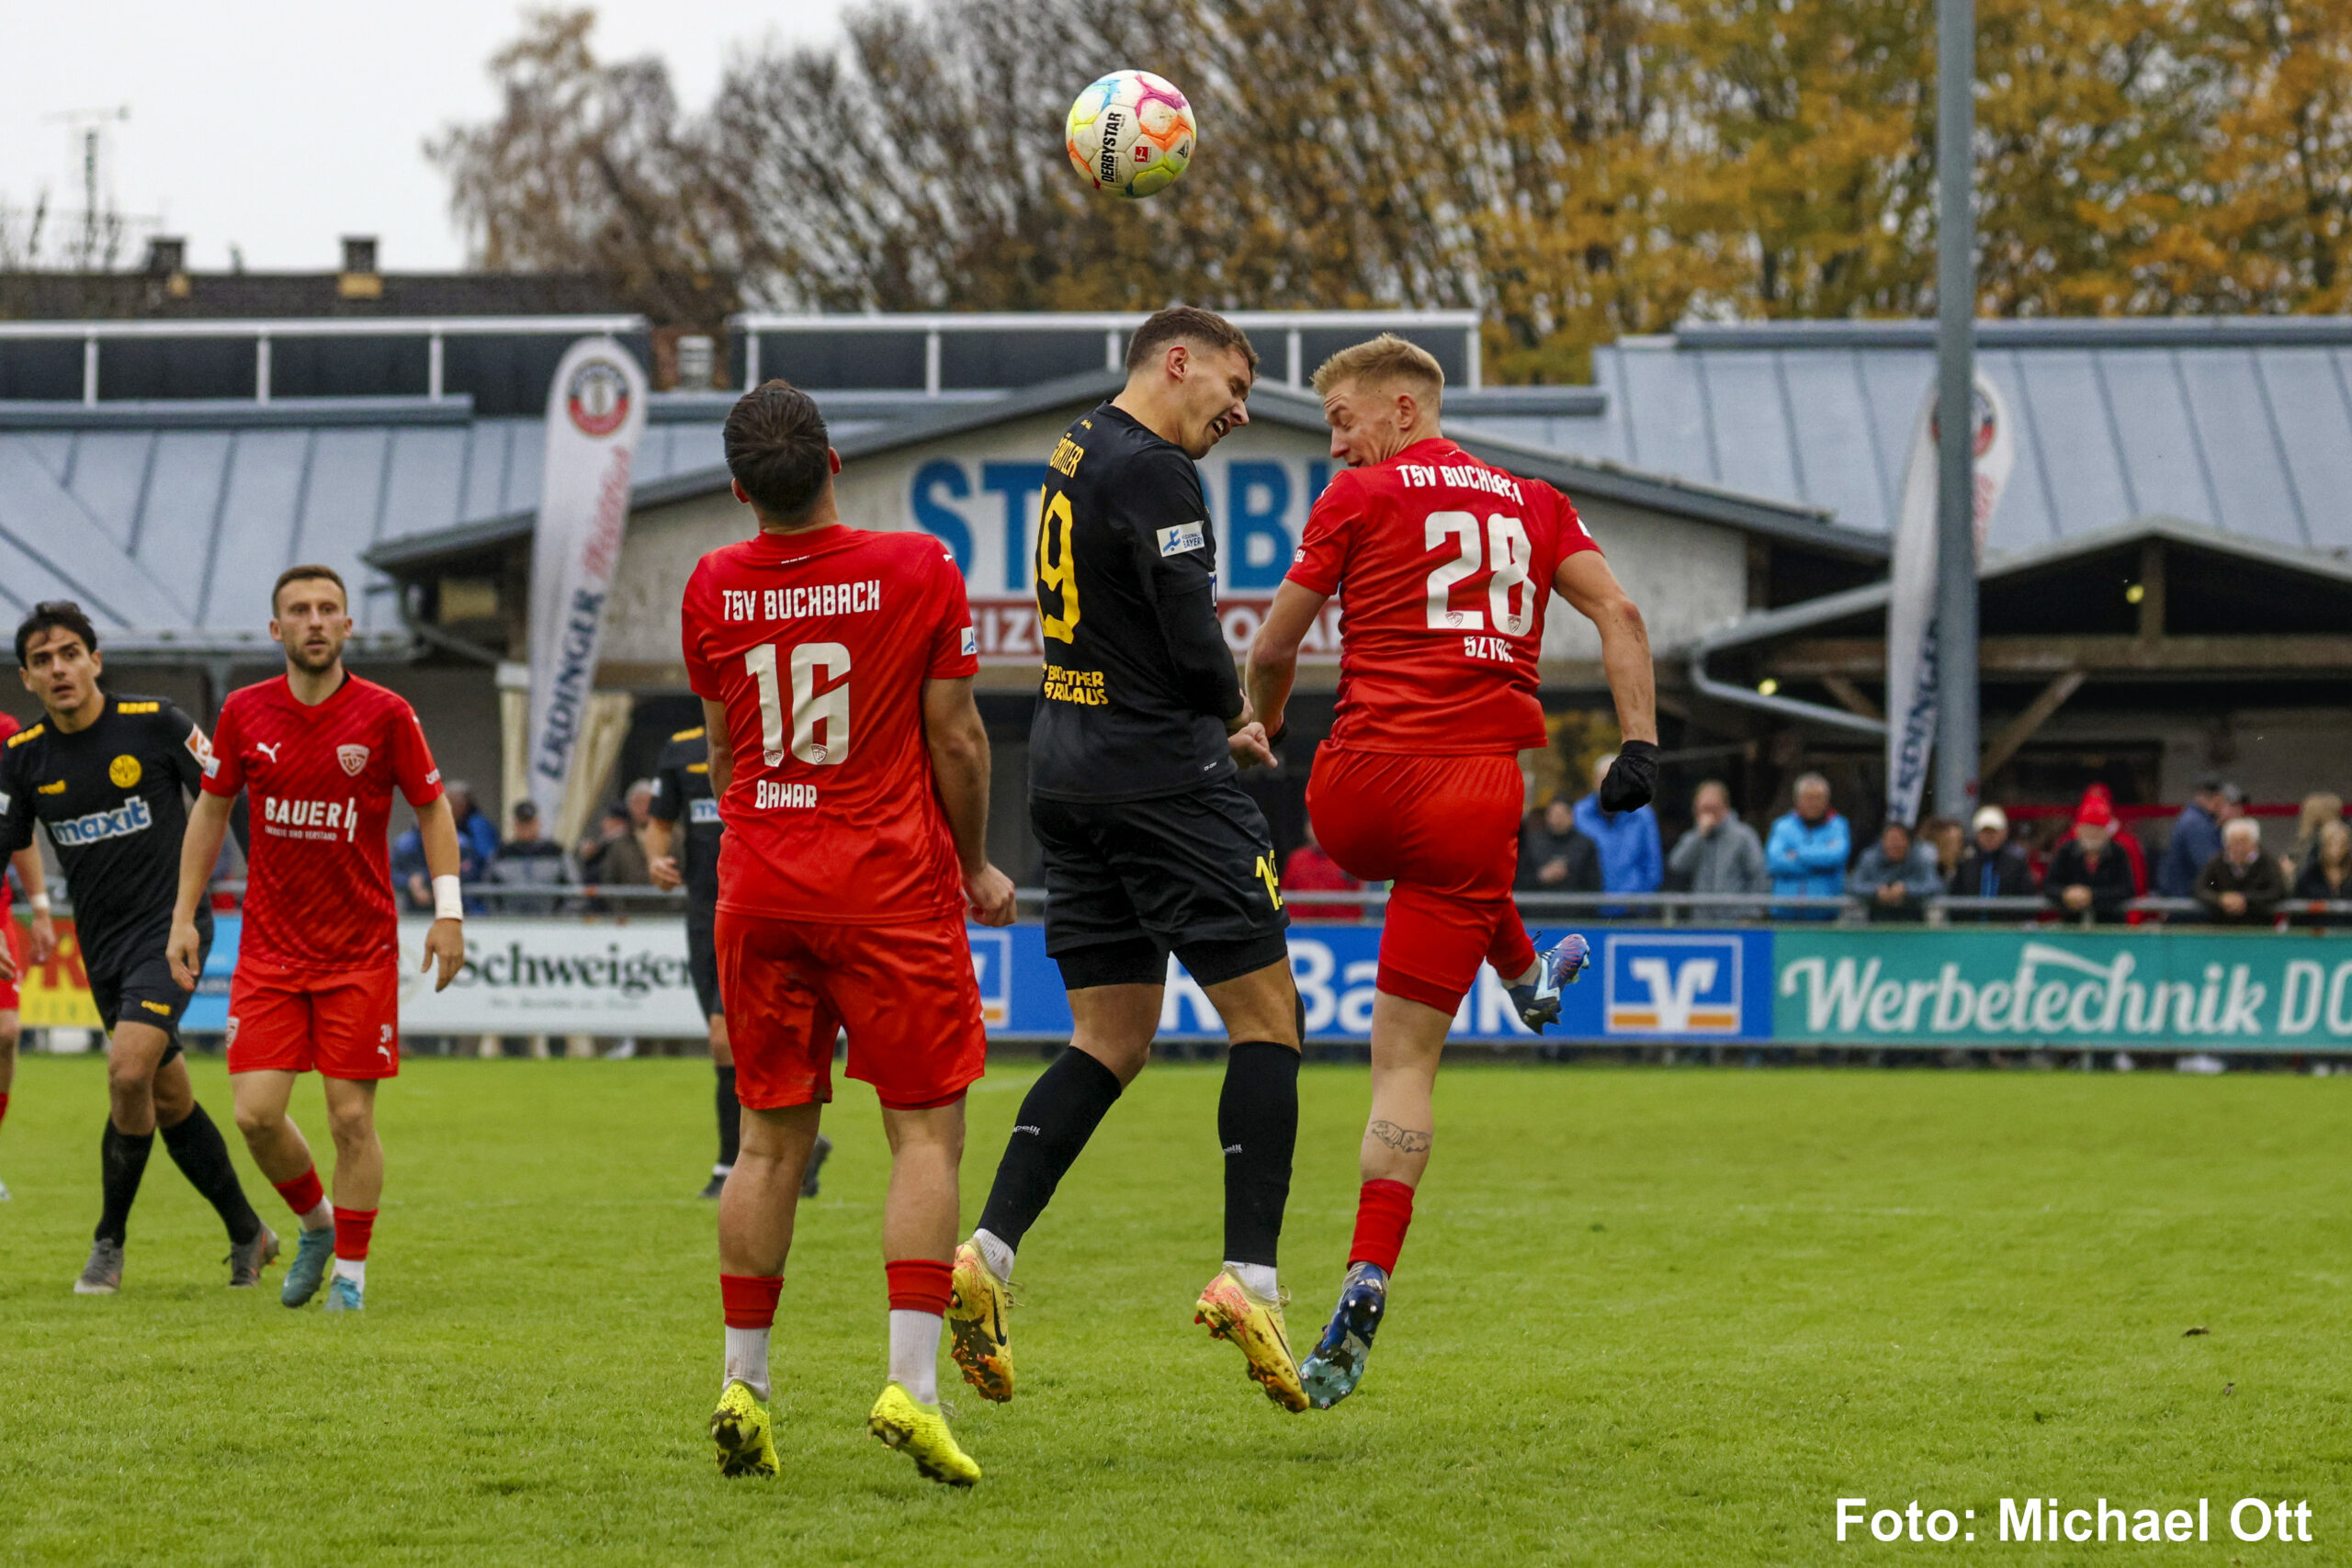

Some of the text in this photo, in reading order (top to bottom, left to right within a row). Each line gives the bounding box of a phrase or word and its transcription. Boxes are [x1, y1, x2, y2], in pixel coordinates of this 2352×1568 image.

[1101, 112, 1122, 183] DERBYSTAR
[1396, 464, 1437, 488] TSV
[1425, 511, 1537, 637] 28
[722, 580, 880, 621] TSV BUCHBACH
[744, 642, 851, 767] 16
[265, 796, 343, 828] BAUER
[754, 779, 818, 809] BAHAR
[52, 797, 151, 844] maxit
[1781, 942, 2267, 1035] Werbetechnik
